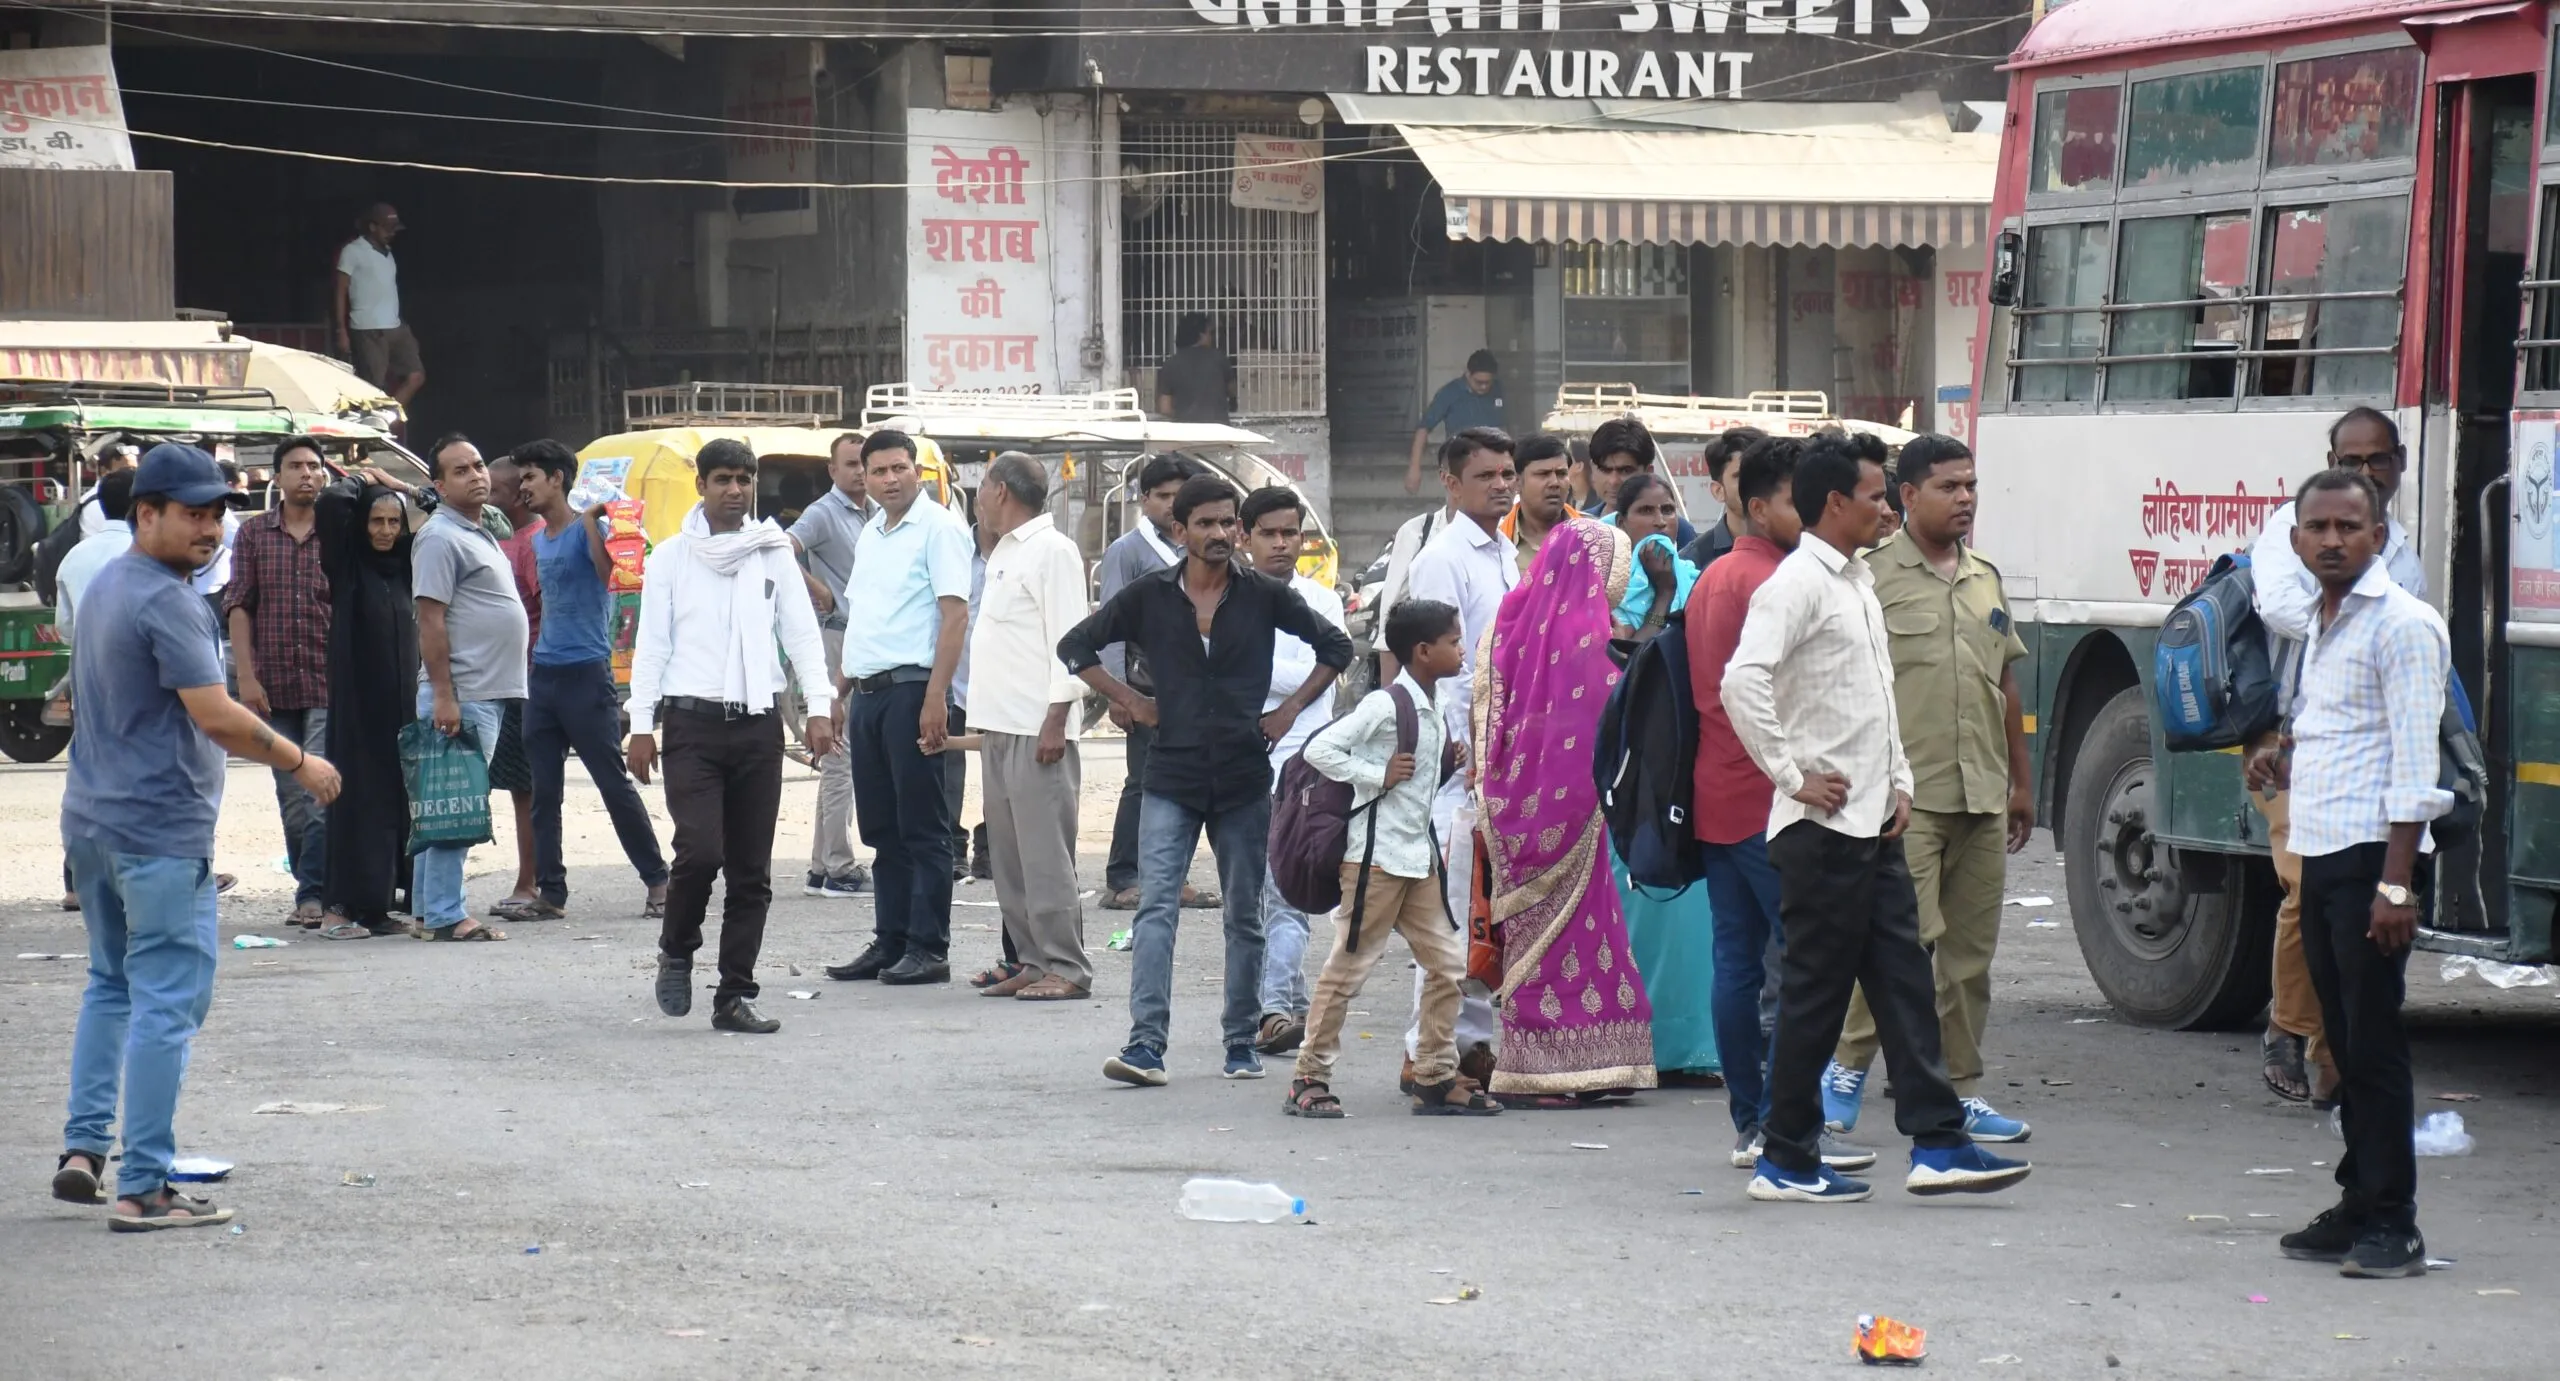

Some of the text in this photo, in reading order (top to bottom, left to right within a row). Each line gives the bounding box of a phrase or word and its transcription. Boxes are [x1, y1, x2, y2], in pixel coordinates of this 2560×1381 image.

[1366, 46, 1754, 99] RESTAURANT
[931, 145, 1030, 204] देशी
[922, 219, 1040, 263] शराब
[957, 278, 1005, 318] की
[923, 334, 1039, 386] दुकान
[2142, 477, 2204, 543] लोहिया
[2205, 480, 2270, 540] ग्रामीण
[409, 795, 487, 819] DECENT
